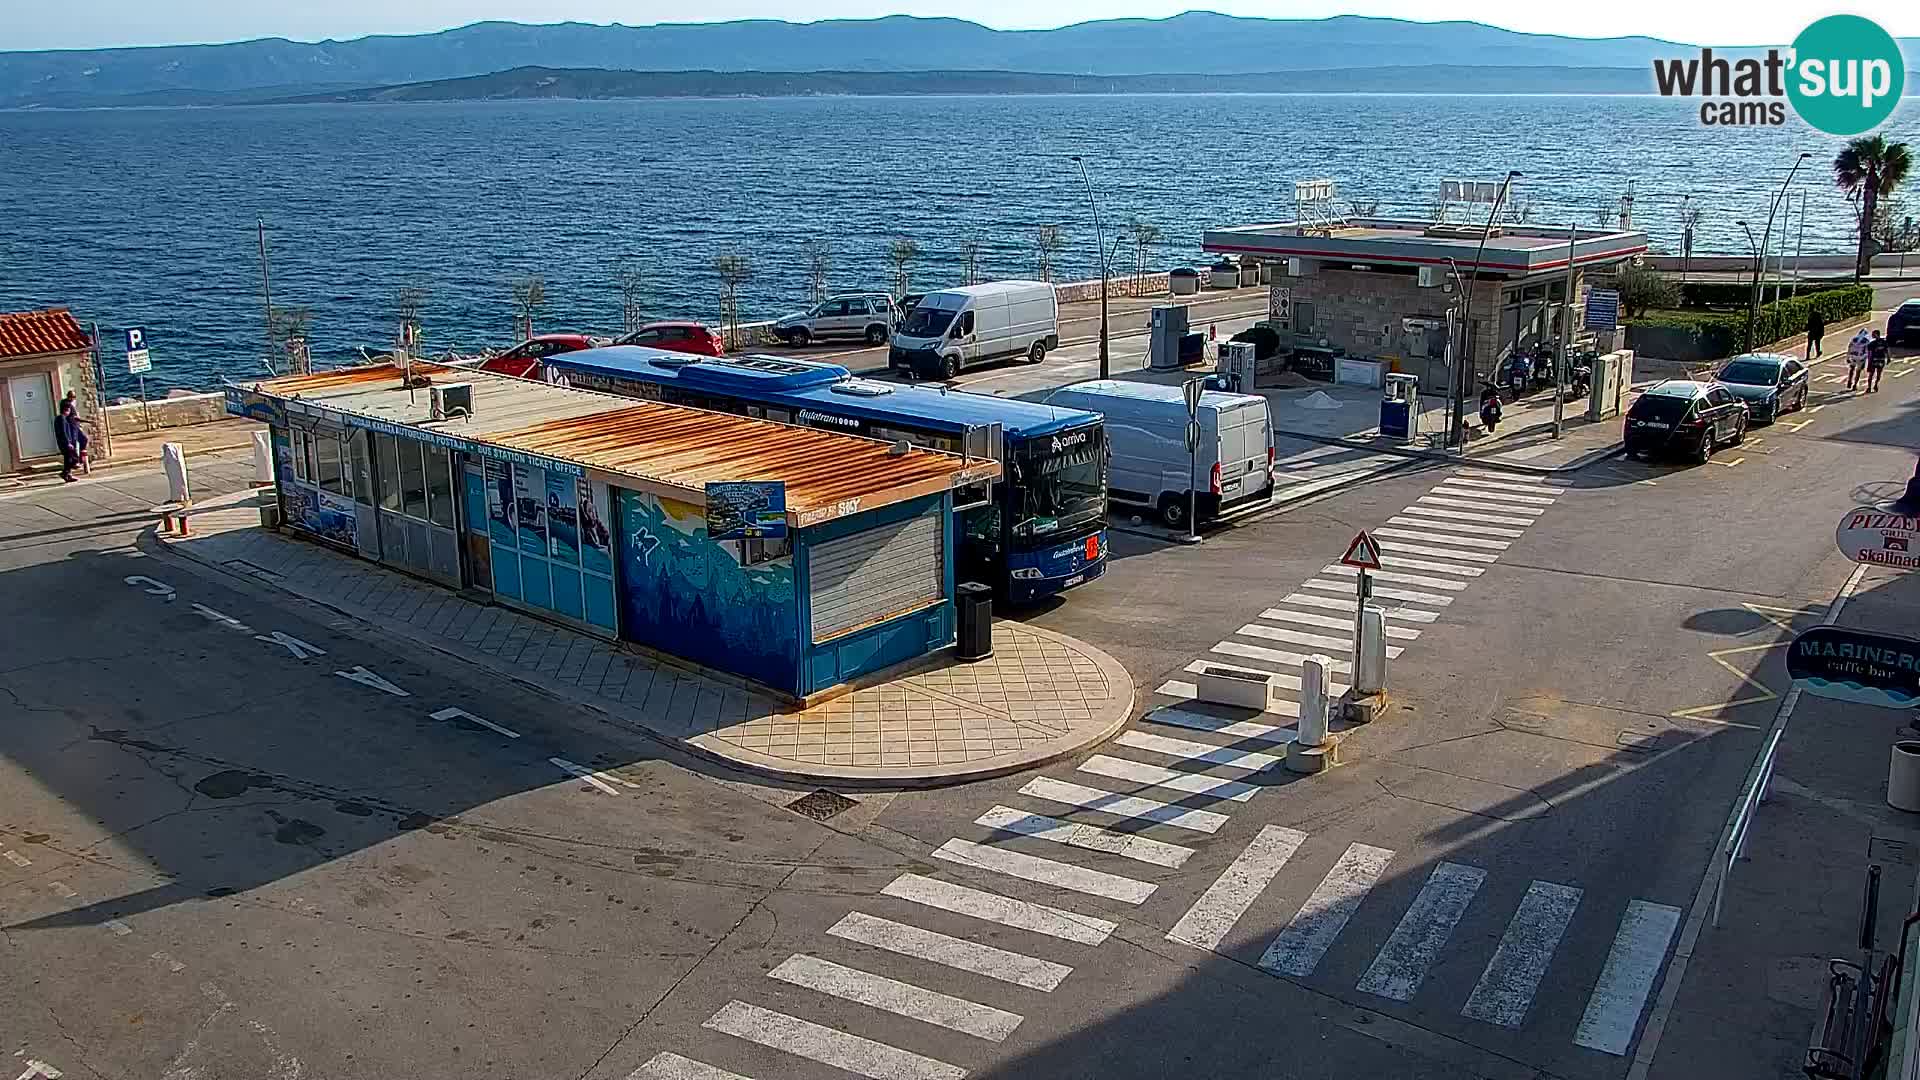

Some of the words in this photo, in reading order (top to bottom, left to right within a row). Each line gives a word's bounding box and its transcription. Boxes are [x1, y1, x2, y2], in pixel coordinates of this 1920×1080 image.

[128, 329, 142, 349] P
[436, 435, 467, 451] POSTAJA
[478, 447, 492, 456] BUS
[493, 448, 526, 464] STATION
[527, 456, 553, 470] TICKET
[555, 462, 582, 476] OFFICE
[838, 499, 861, 516] SKY
[1847, 513, 1920, 532] PIZZE
[1868, 664, 1896, 679] bar
